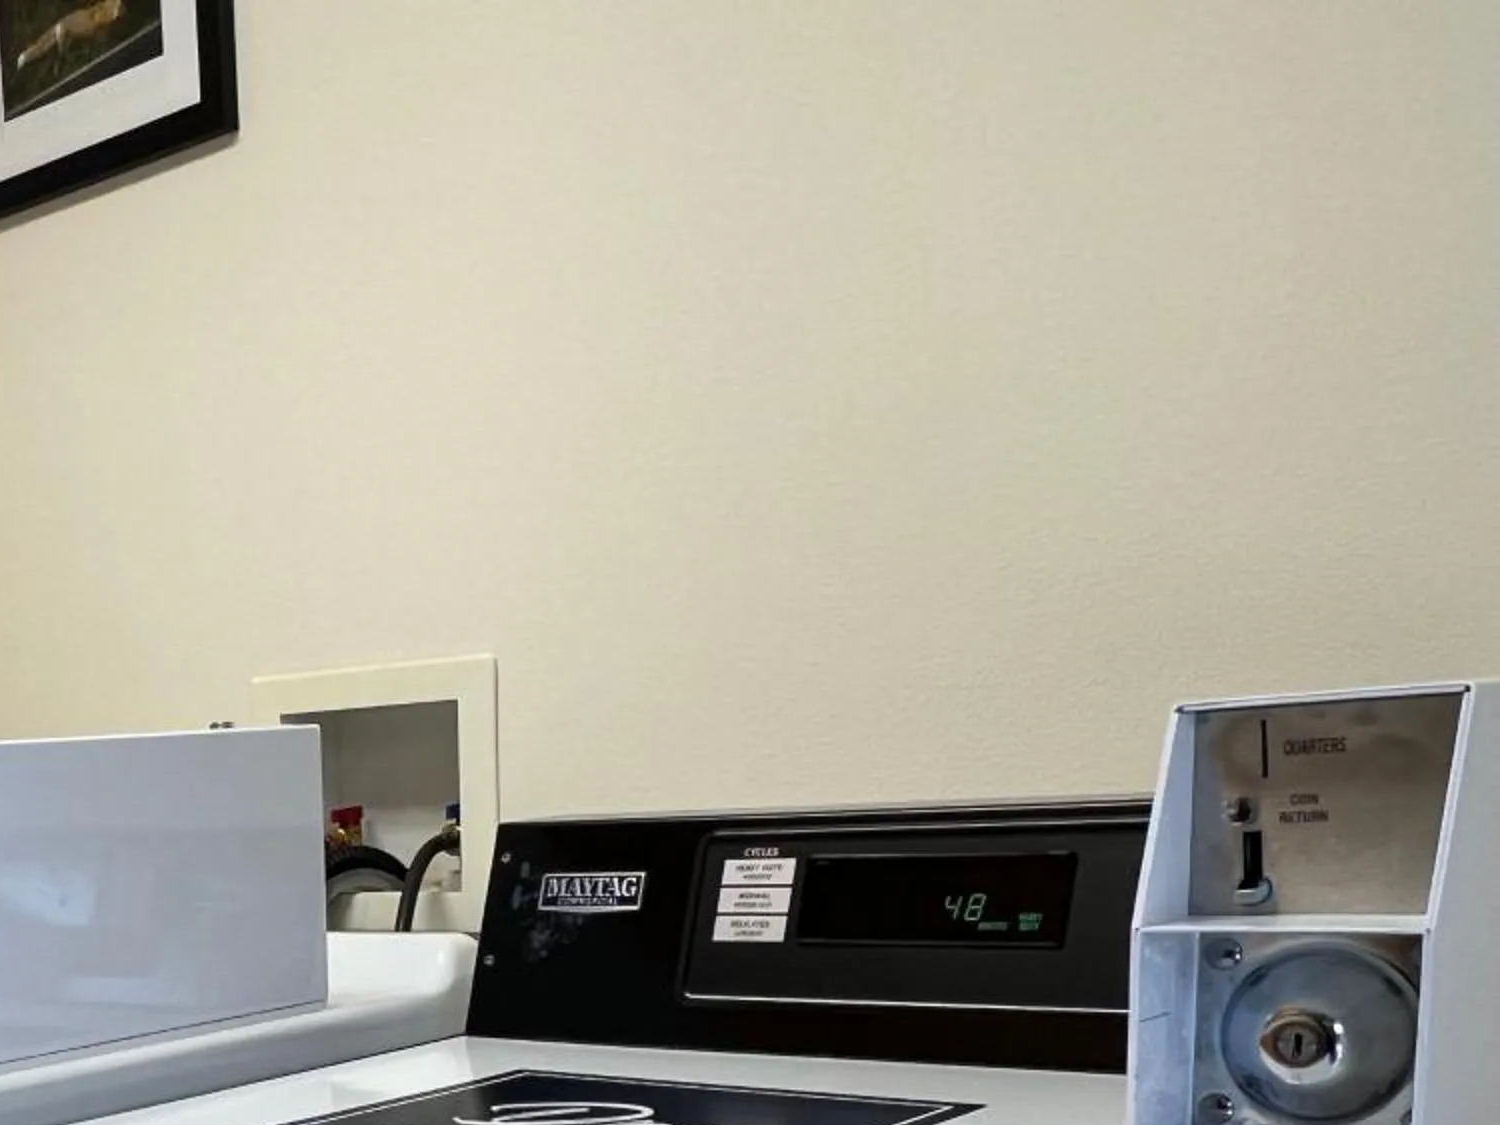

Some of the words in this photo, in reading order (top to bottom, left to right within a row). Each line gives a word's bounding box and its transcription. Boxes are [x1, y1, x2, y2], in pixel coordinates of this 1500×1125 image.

[1283, 736, 1346, 756] QUARTERS
[1289, 793, 1319, 806] COIN
[1279, 810, 1329, 823] RETURN
[743, 847, 780, 857] CYCLES
[546, 877, 637, 897] MAYTAG
[944, 892, 988, 921] 48
